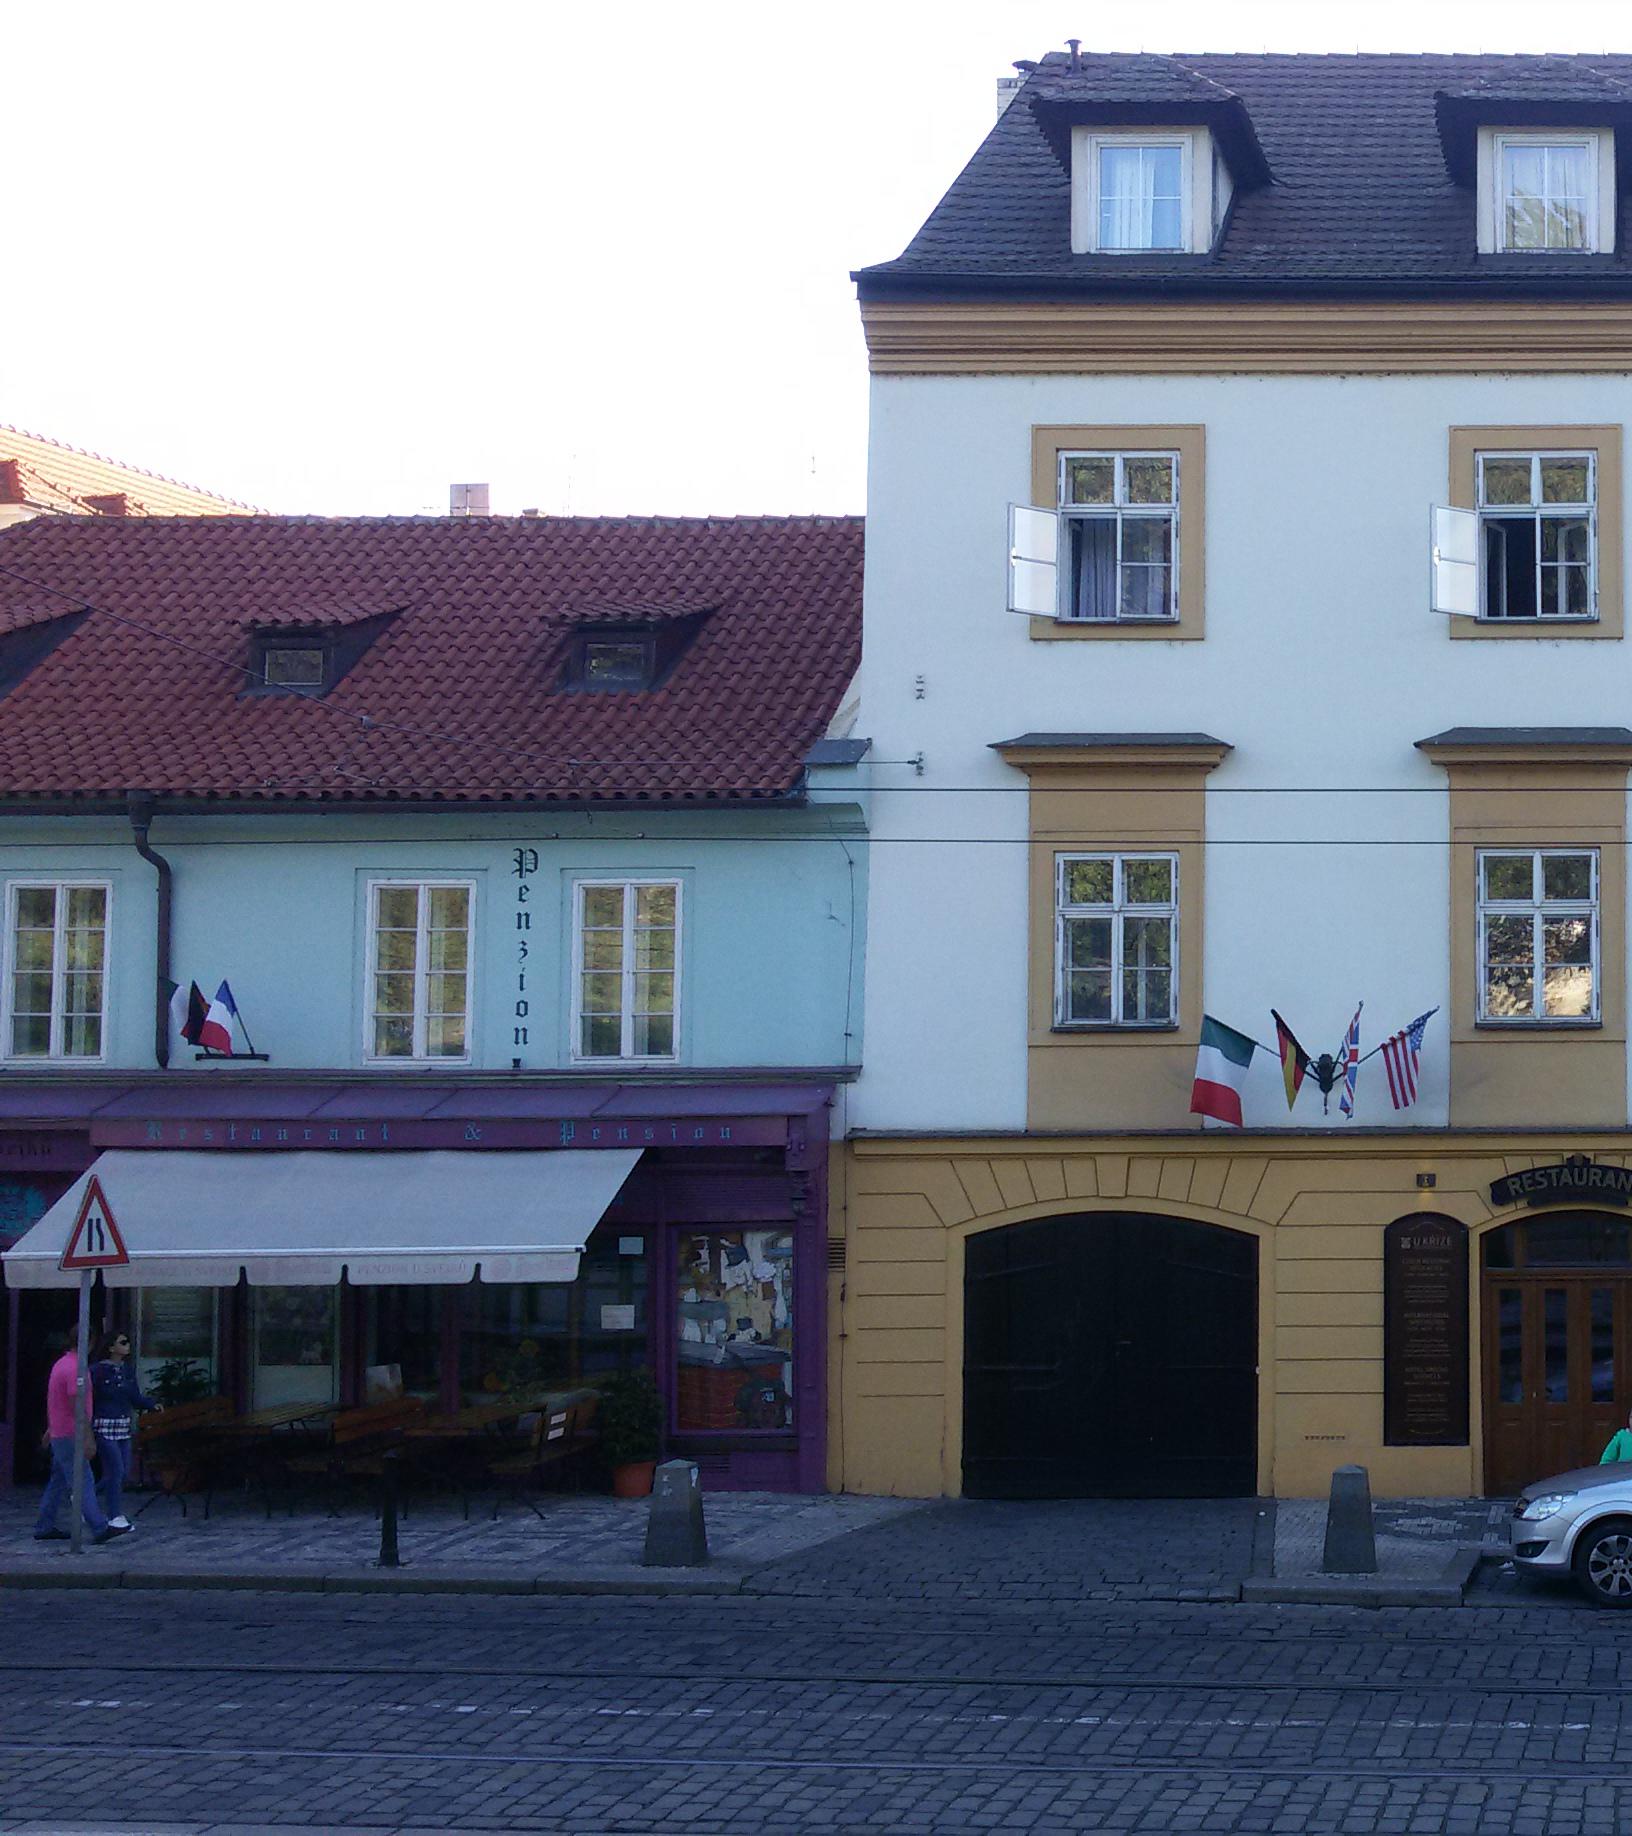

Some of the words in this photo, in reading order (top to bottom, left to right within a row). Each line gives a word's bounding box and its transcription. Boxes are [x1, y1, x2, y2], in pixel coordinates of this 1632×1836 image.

[512, 848, 539, 1046] Penzion
[145, 1121, 391, 1141] Restaurant
[463, 1121, 482, 1142] &
[559, 1119, 733, 1146] Pension
